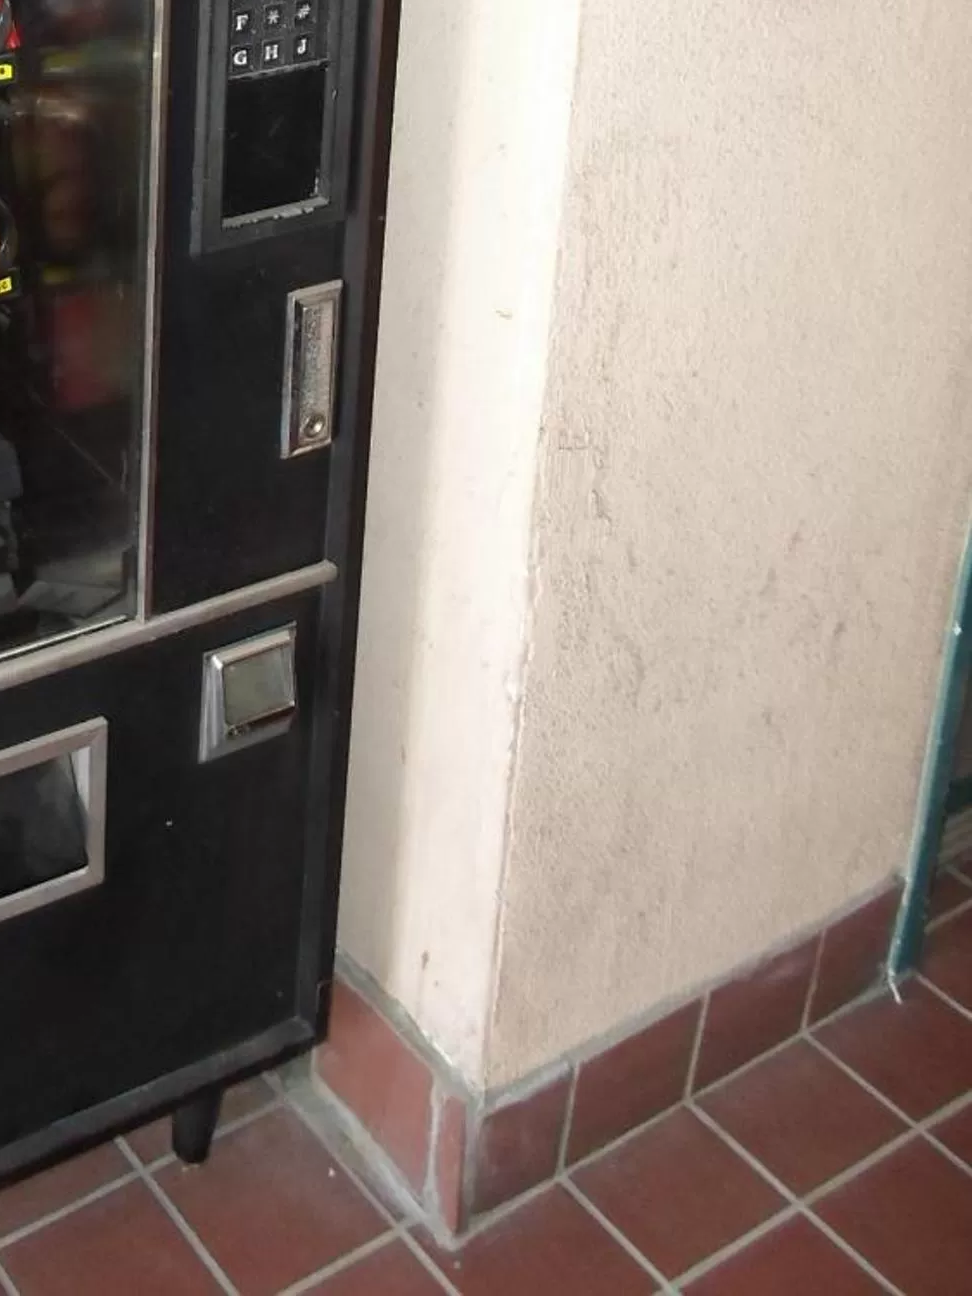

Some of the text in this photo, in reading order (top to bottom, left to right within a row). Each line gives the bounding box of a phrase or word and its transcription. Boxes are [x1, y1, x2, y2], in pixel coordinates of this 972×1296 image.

[235, 14, 249, 31] F
[233, 38, 307, 65] G H J
